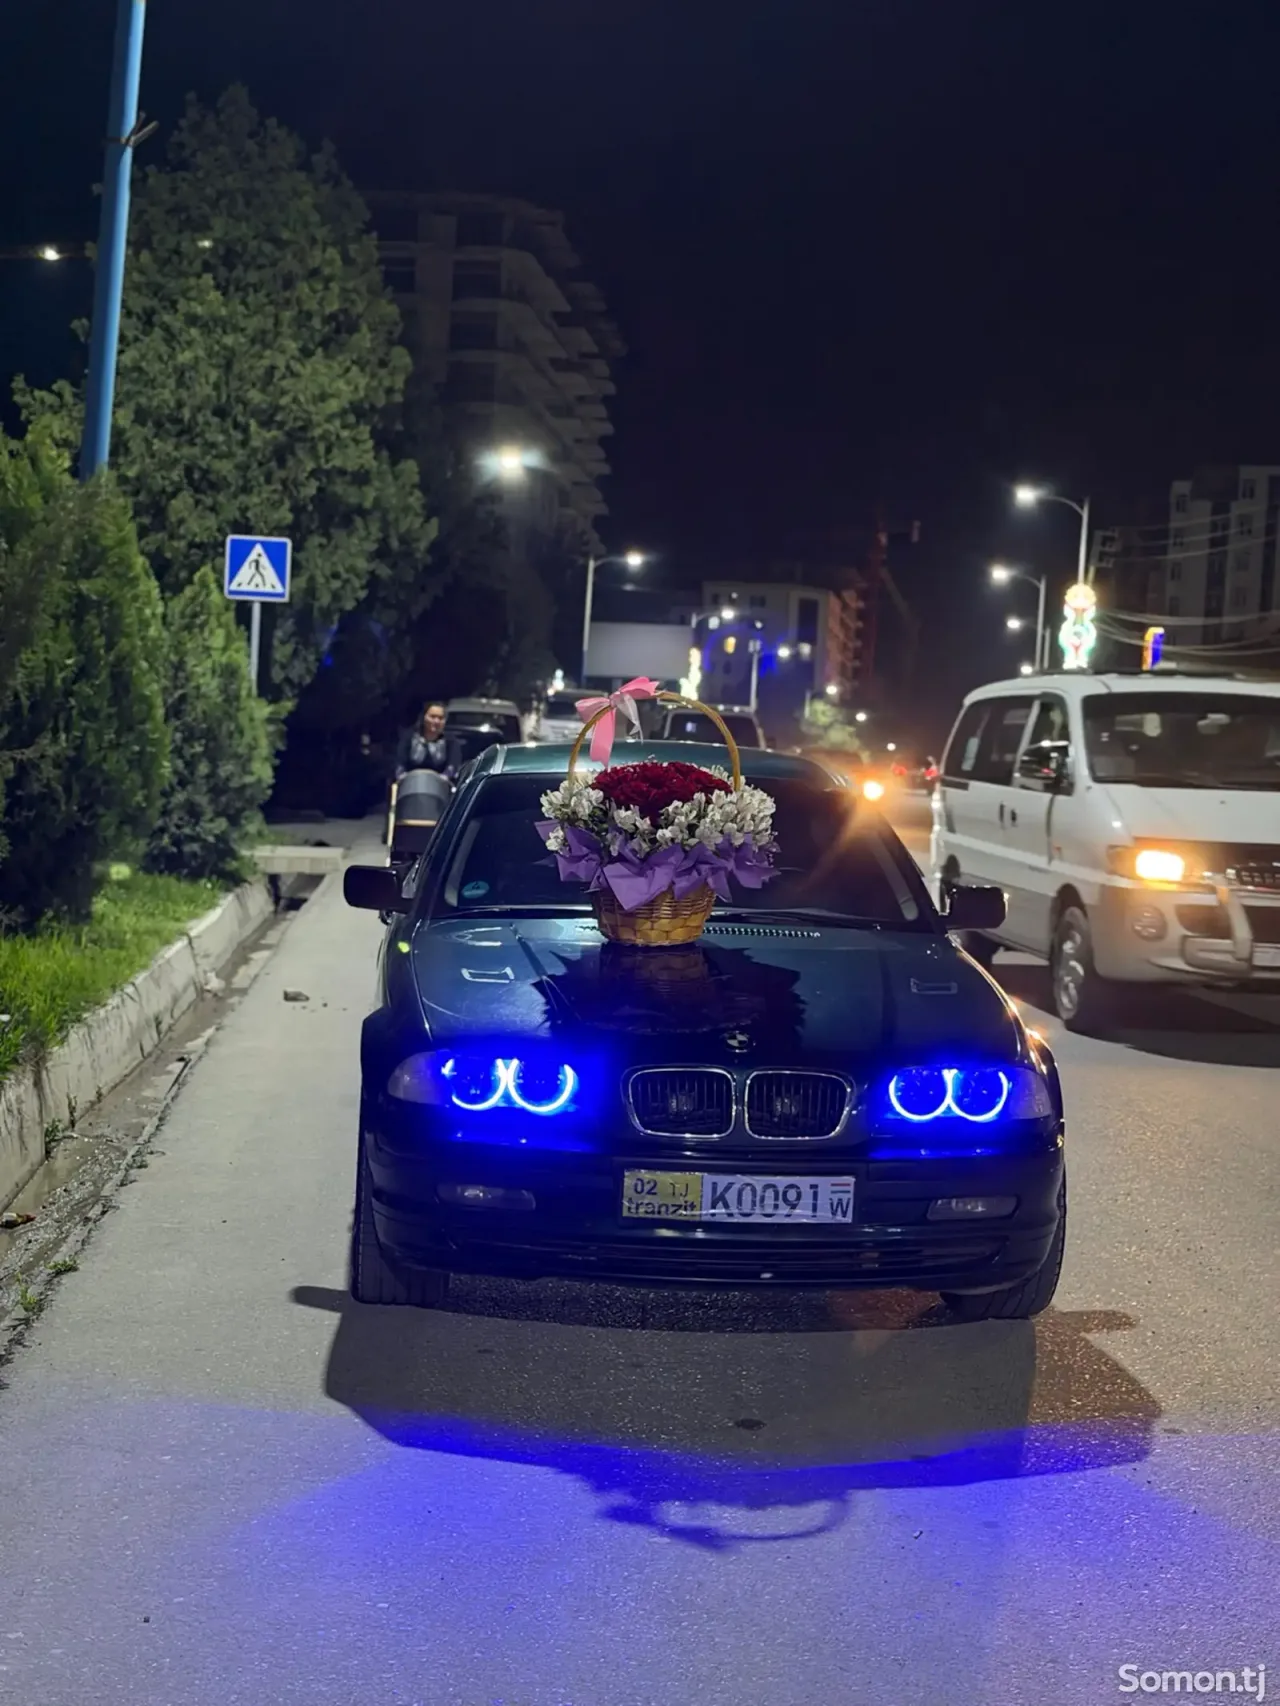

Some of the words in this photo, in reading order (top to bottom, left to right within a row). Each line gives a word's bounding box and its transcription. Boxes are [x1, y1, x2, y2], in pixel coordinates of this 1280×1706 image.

[634, 1177, 658, 1195] 02
[668, 1182, 689, 1198] TJ
[627, 1197, 697, 1216] tranzit
[709, 1181, 819, 1218] K0091
[829, 1197, 851, 1218] W
